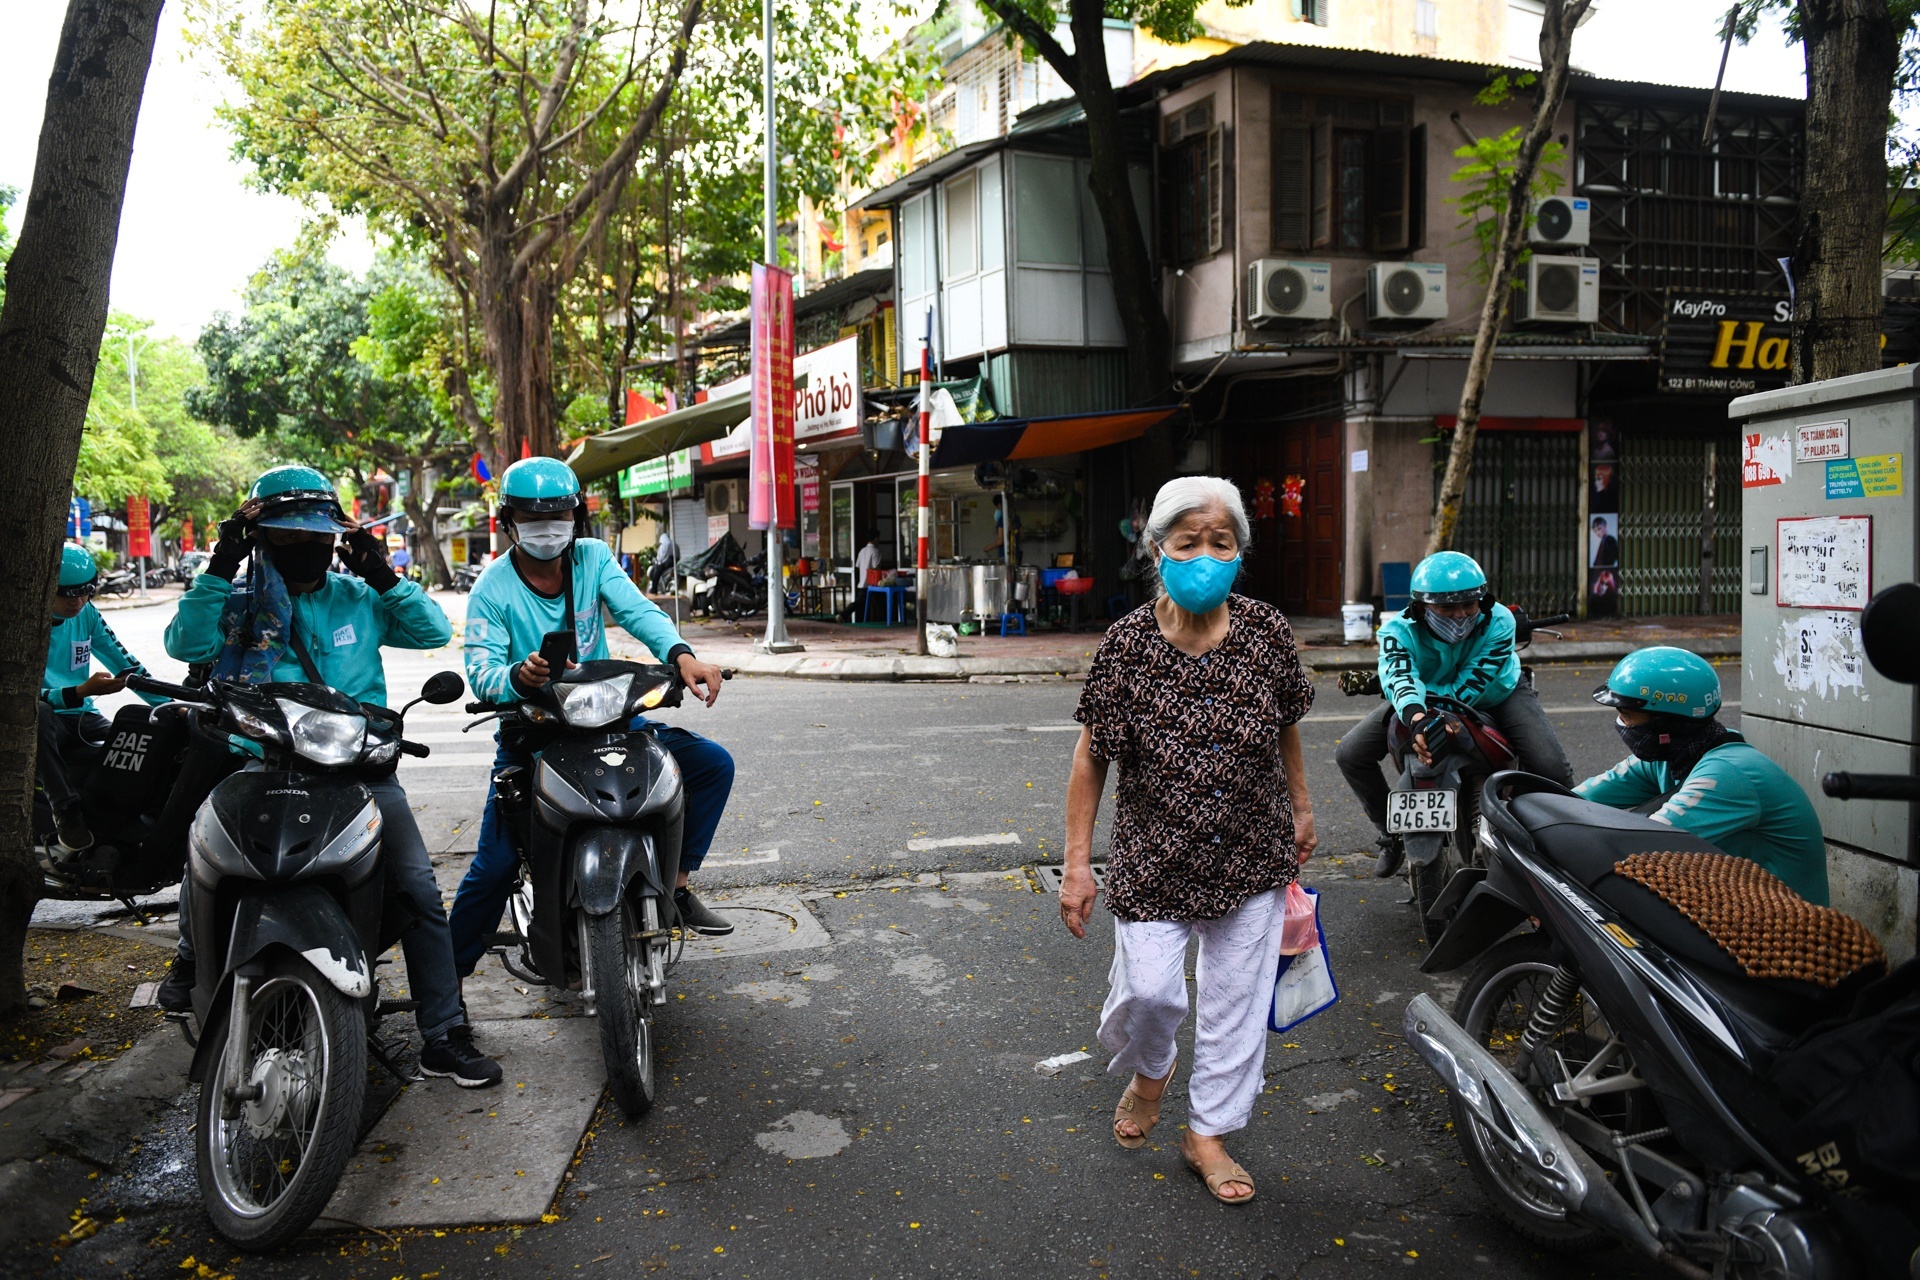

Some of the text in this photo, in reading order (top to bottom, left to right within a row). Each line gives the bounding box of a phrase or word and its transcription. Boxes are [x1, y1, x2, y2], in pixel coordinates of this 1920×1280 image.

[1673, 300, 1726, 318] KayPro
[1668, 377, 1756, 390] 122 B1 THÀNH CÔNG
[794, 377, 826, 421] Phở
[830, 372, 852, 413] bò
[1826, 427, 1839, 438] CÔNG
[1840, 428, 1843, 437] 4
[1810, 445, 1825, 456] PILLAR
[1744, 465, 1757, 482] 088
[1829, 464, 1853, 472] INTERNET
[112, 731, 152, 752] BAE
[594, 746, 628, 754] HONDA
[103, 750, 145, 772] MIN
[1399, 792, 1446, 810] 36-B2
[1393, 811, 1451, 830] 946.54
